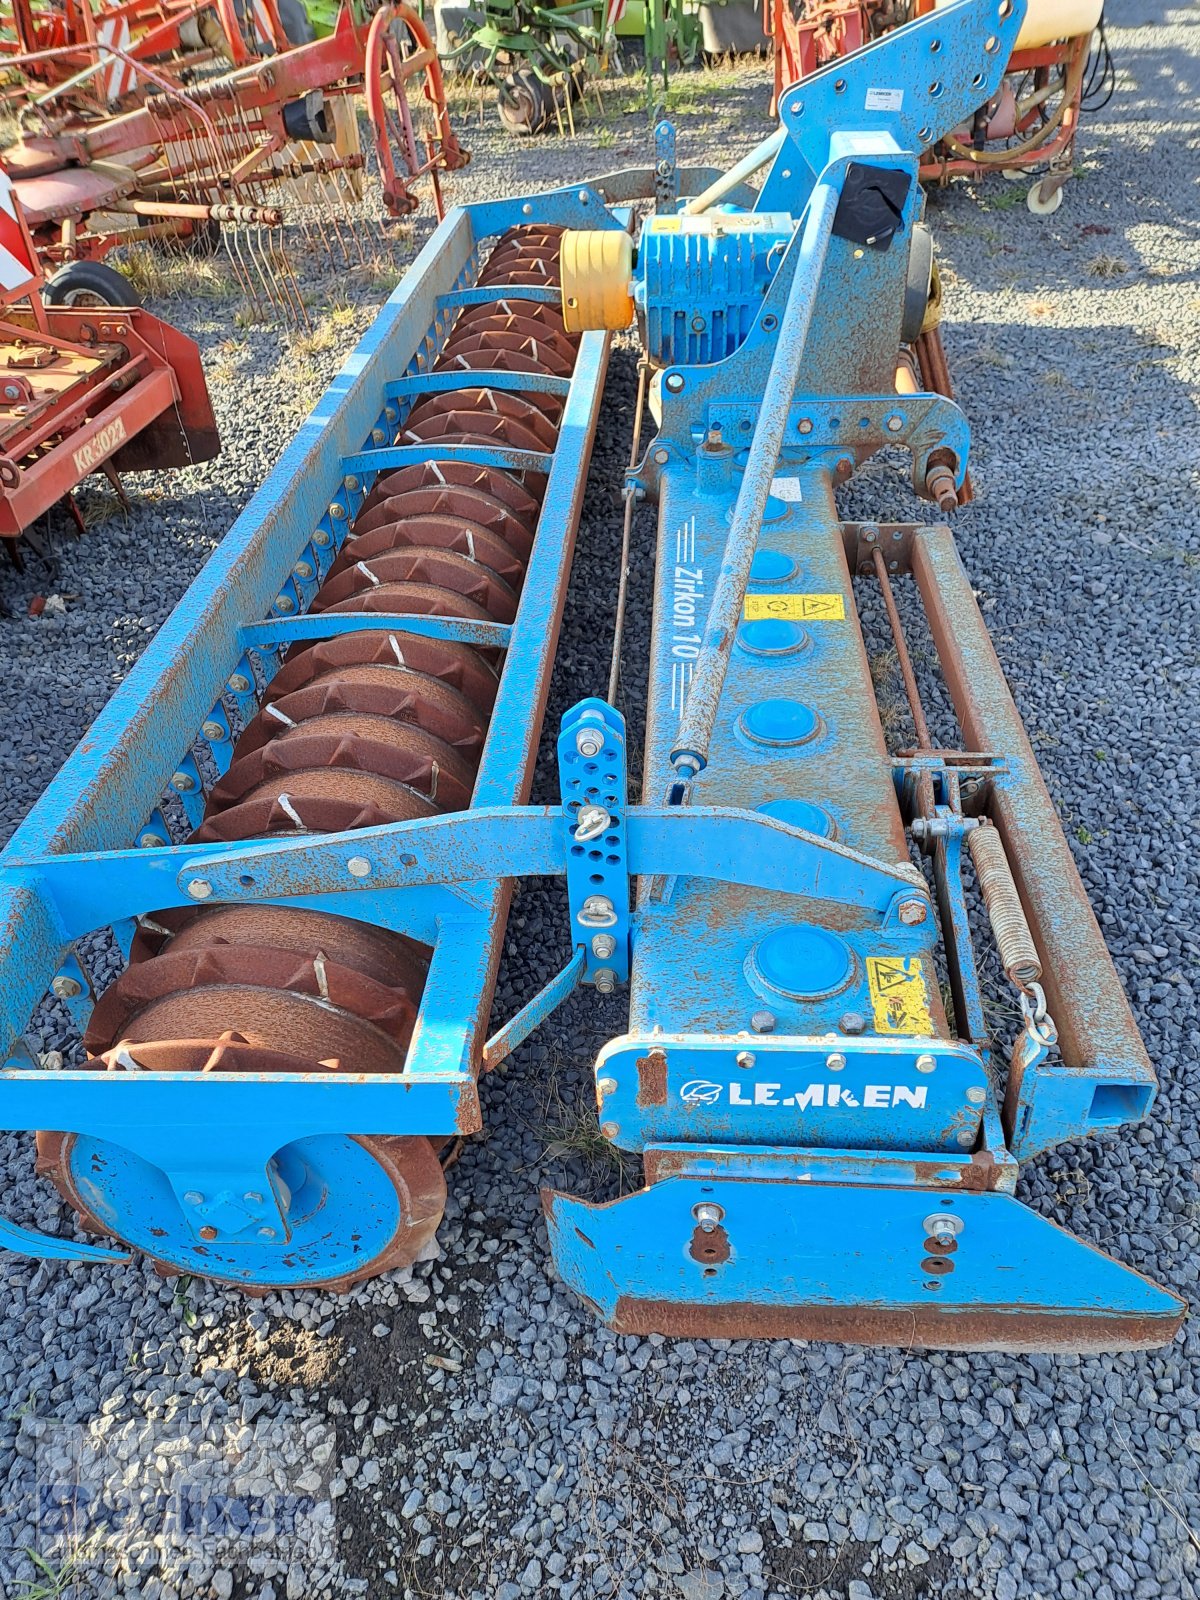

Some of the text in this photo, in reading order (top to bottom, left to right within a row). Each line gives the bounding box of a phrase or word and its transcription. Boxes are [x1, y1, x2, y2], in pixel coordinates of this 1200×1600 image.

[671, 566, 704, 658] Zirkon 10
[729, 1082, 928, 1112] LEMKEN
